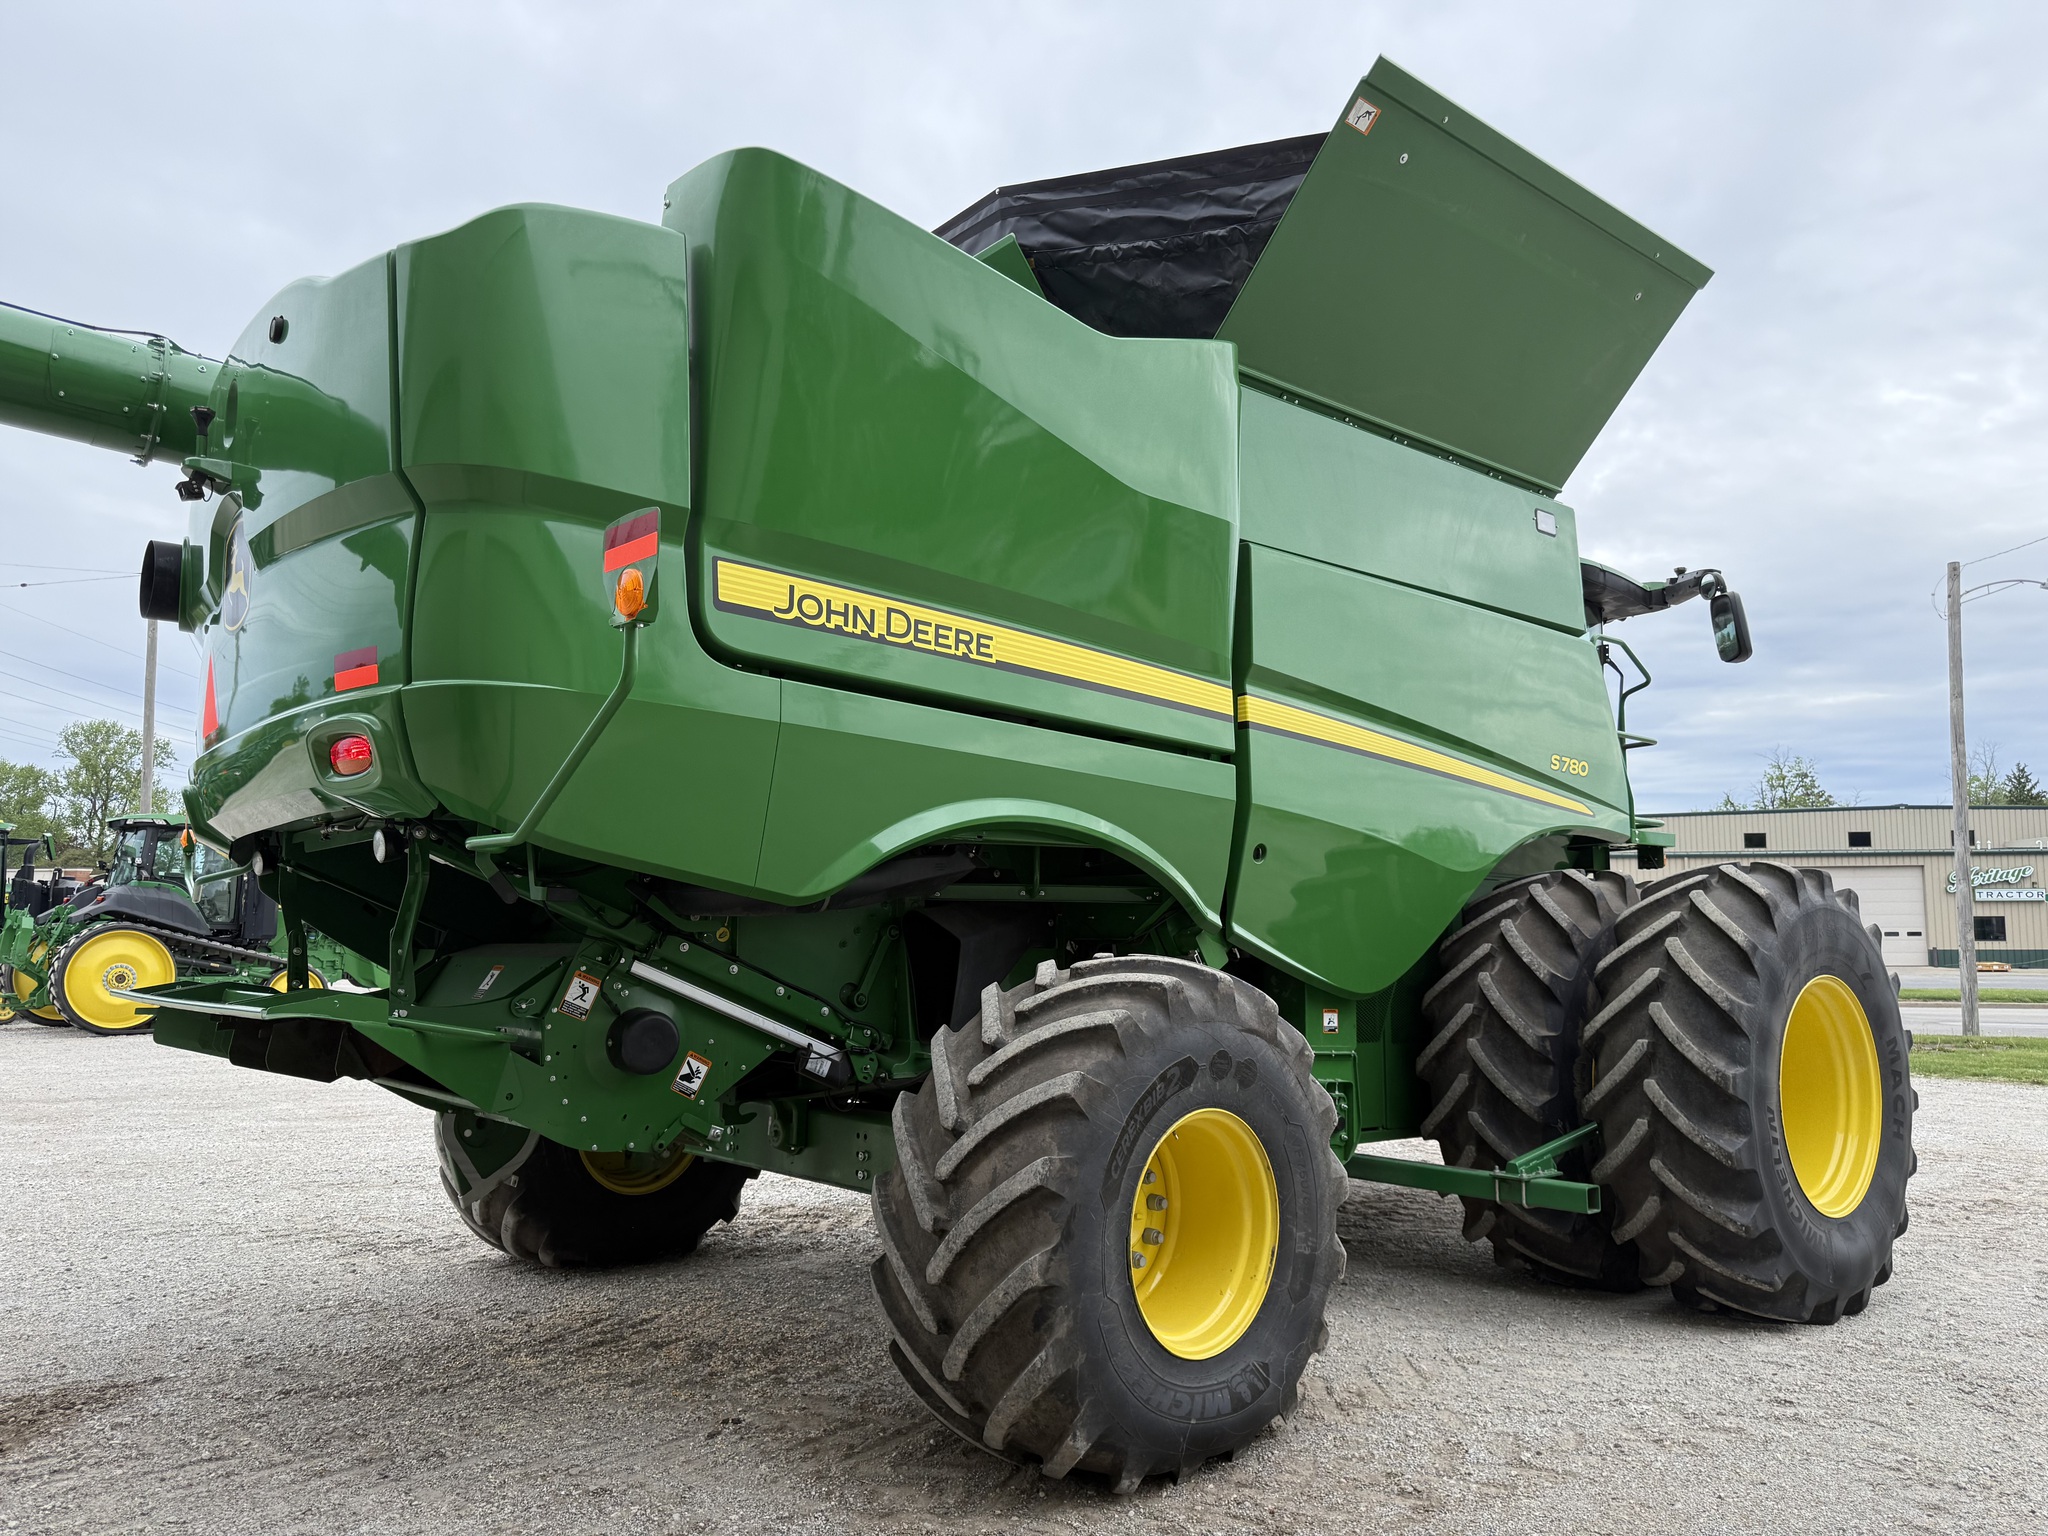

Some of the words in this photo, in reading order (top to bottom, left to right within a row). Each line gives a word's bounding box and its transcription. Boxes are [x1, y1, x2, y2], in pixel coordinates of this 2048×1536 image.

[773, 584, 876, 635] JOHN
[886, 606, 995, 660] DEERE
[1550, 754, 1589, 777] S780
[1977, 891, 2045, 899] TRACTOR
[1886, 1036, 1906, 1142] MACH
[1766, 1105, 1826, 1249] MICHELIN
